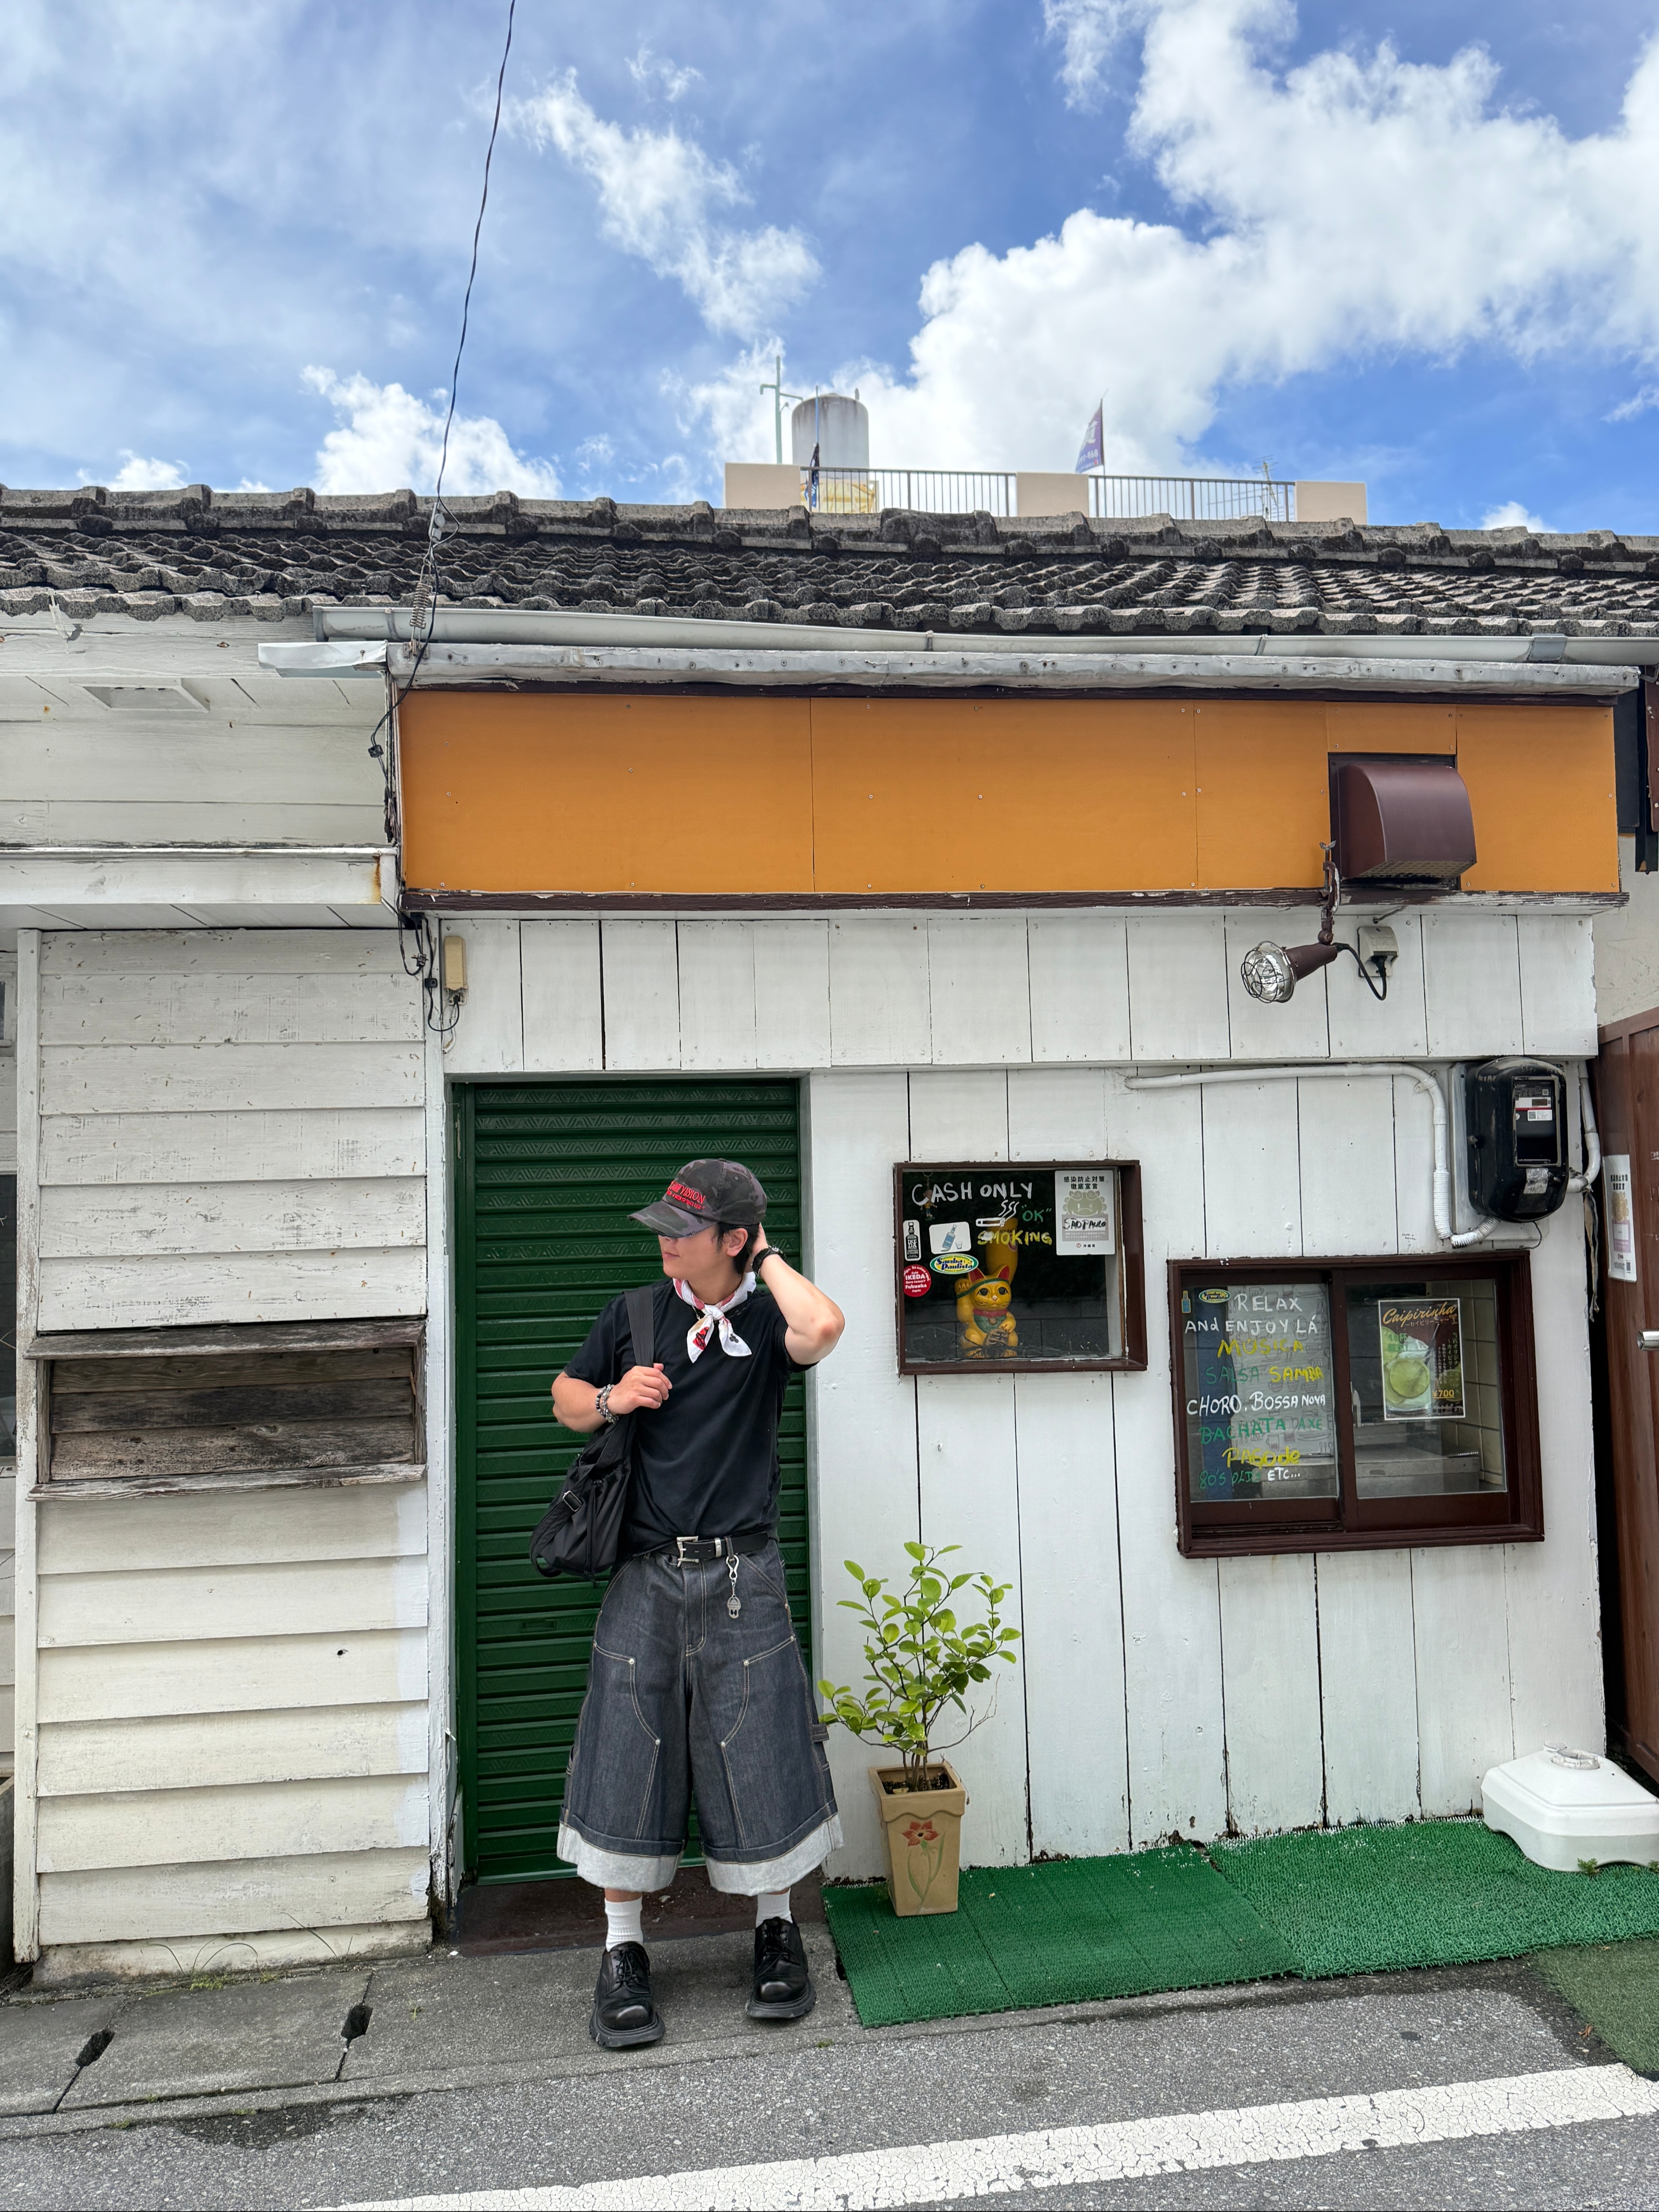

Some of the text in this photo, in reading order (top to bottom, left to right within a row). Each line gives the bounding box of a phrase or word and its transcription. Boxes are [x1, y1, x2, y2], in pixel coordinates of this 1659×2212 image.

[911, 1182, 1033, 1206] CASH ONLY
[977, 1229, 1052, 1245] SMOKING
[1233, 1293, 1303, 1312] RELAX
[1382, 1301, 1457, 1327] Caipirinha
[1225, 1319, 1289, 1336] ENJOY
[1205, 1366, 1323, 1385] SALSA SAMBA
[1249, 1391, 1298, 1411] BOSSA
[1301, 1394, 1326, 1406] NOVA
[1198, 1418, 1286, 1444] BACHATA
